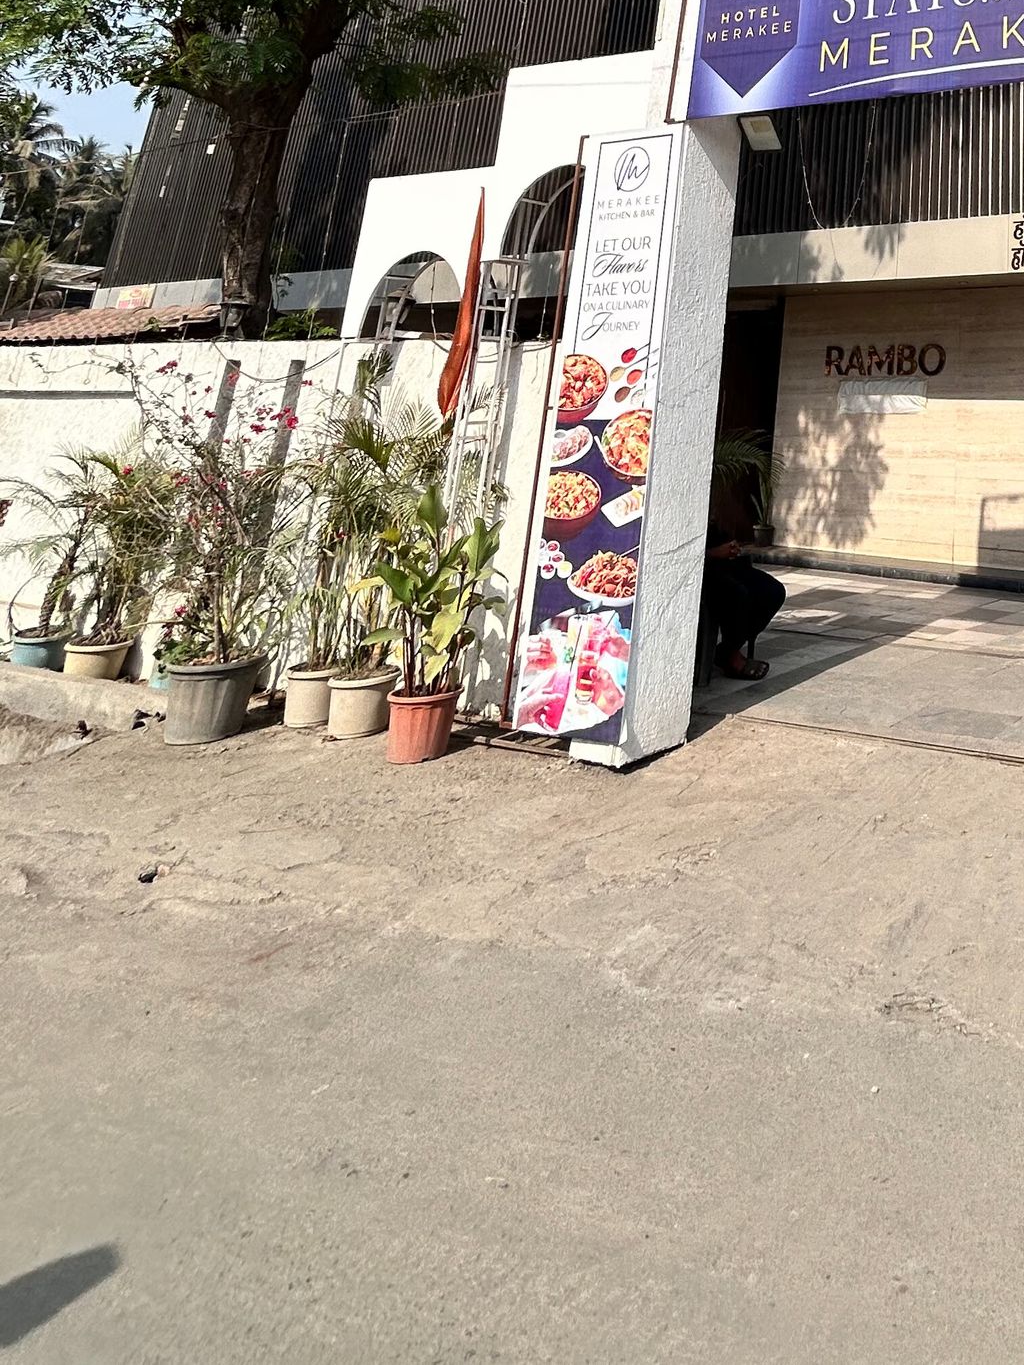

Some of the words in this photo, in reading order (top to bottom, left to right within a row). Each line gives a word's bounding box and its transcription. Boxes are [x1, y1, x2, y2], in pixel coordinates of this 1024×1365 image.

[720, 5, 780, 25] HOTEL
[705, 20, 793, 44] MERAKEE
[596, 194, 661, 210] MERAKEE
[598, 210, 631, 222] KITCHEN
[632, 210, 639, 219] &
[640, 208, 655, 218] BAR
[595, 238, 620, 254] LET
[621, 235, 652, 251] OUR
[591, 252, 649, 278] Flavors
[585, 281, 620, 297] TAKE
[622, 279, 652, 295] YOU
[583, 302, 597, 313] ON
[597, 302, 604, 312] A
[605, 299, 650, 312] CULINARY
[581, 311, 640, 341] JOURNEY
[824, 343, 947, 377] RAMBO
